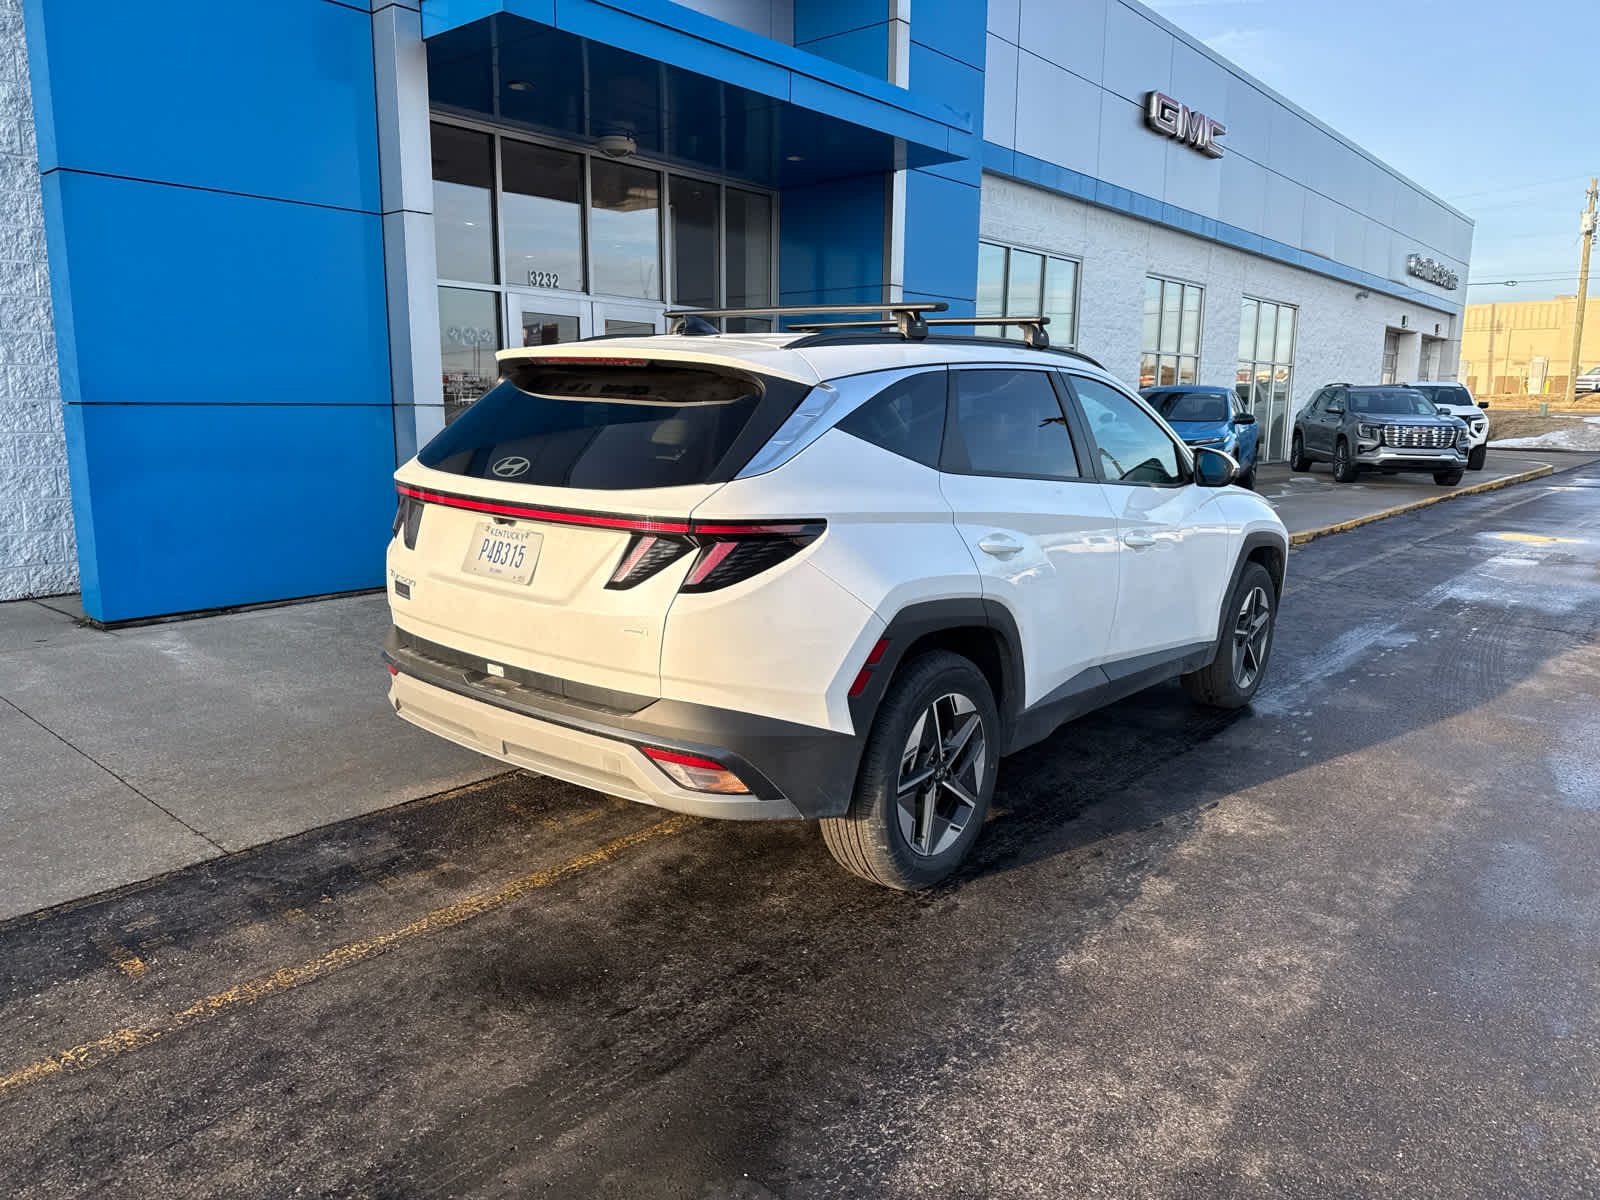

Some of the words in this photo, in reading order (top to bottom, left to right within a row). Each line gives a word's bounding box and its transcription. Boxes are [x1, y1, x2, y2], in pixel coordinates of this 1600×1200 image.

[1144, 89, 1227, 159] GMC
[490, 527, 525, 541] KENTUCKY
[478, 538, 526, 568] P4B315
